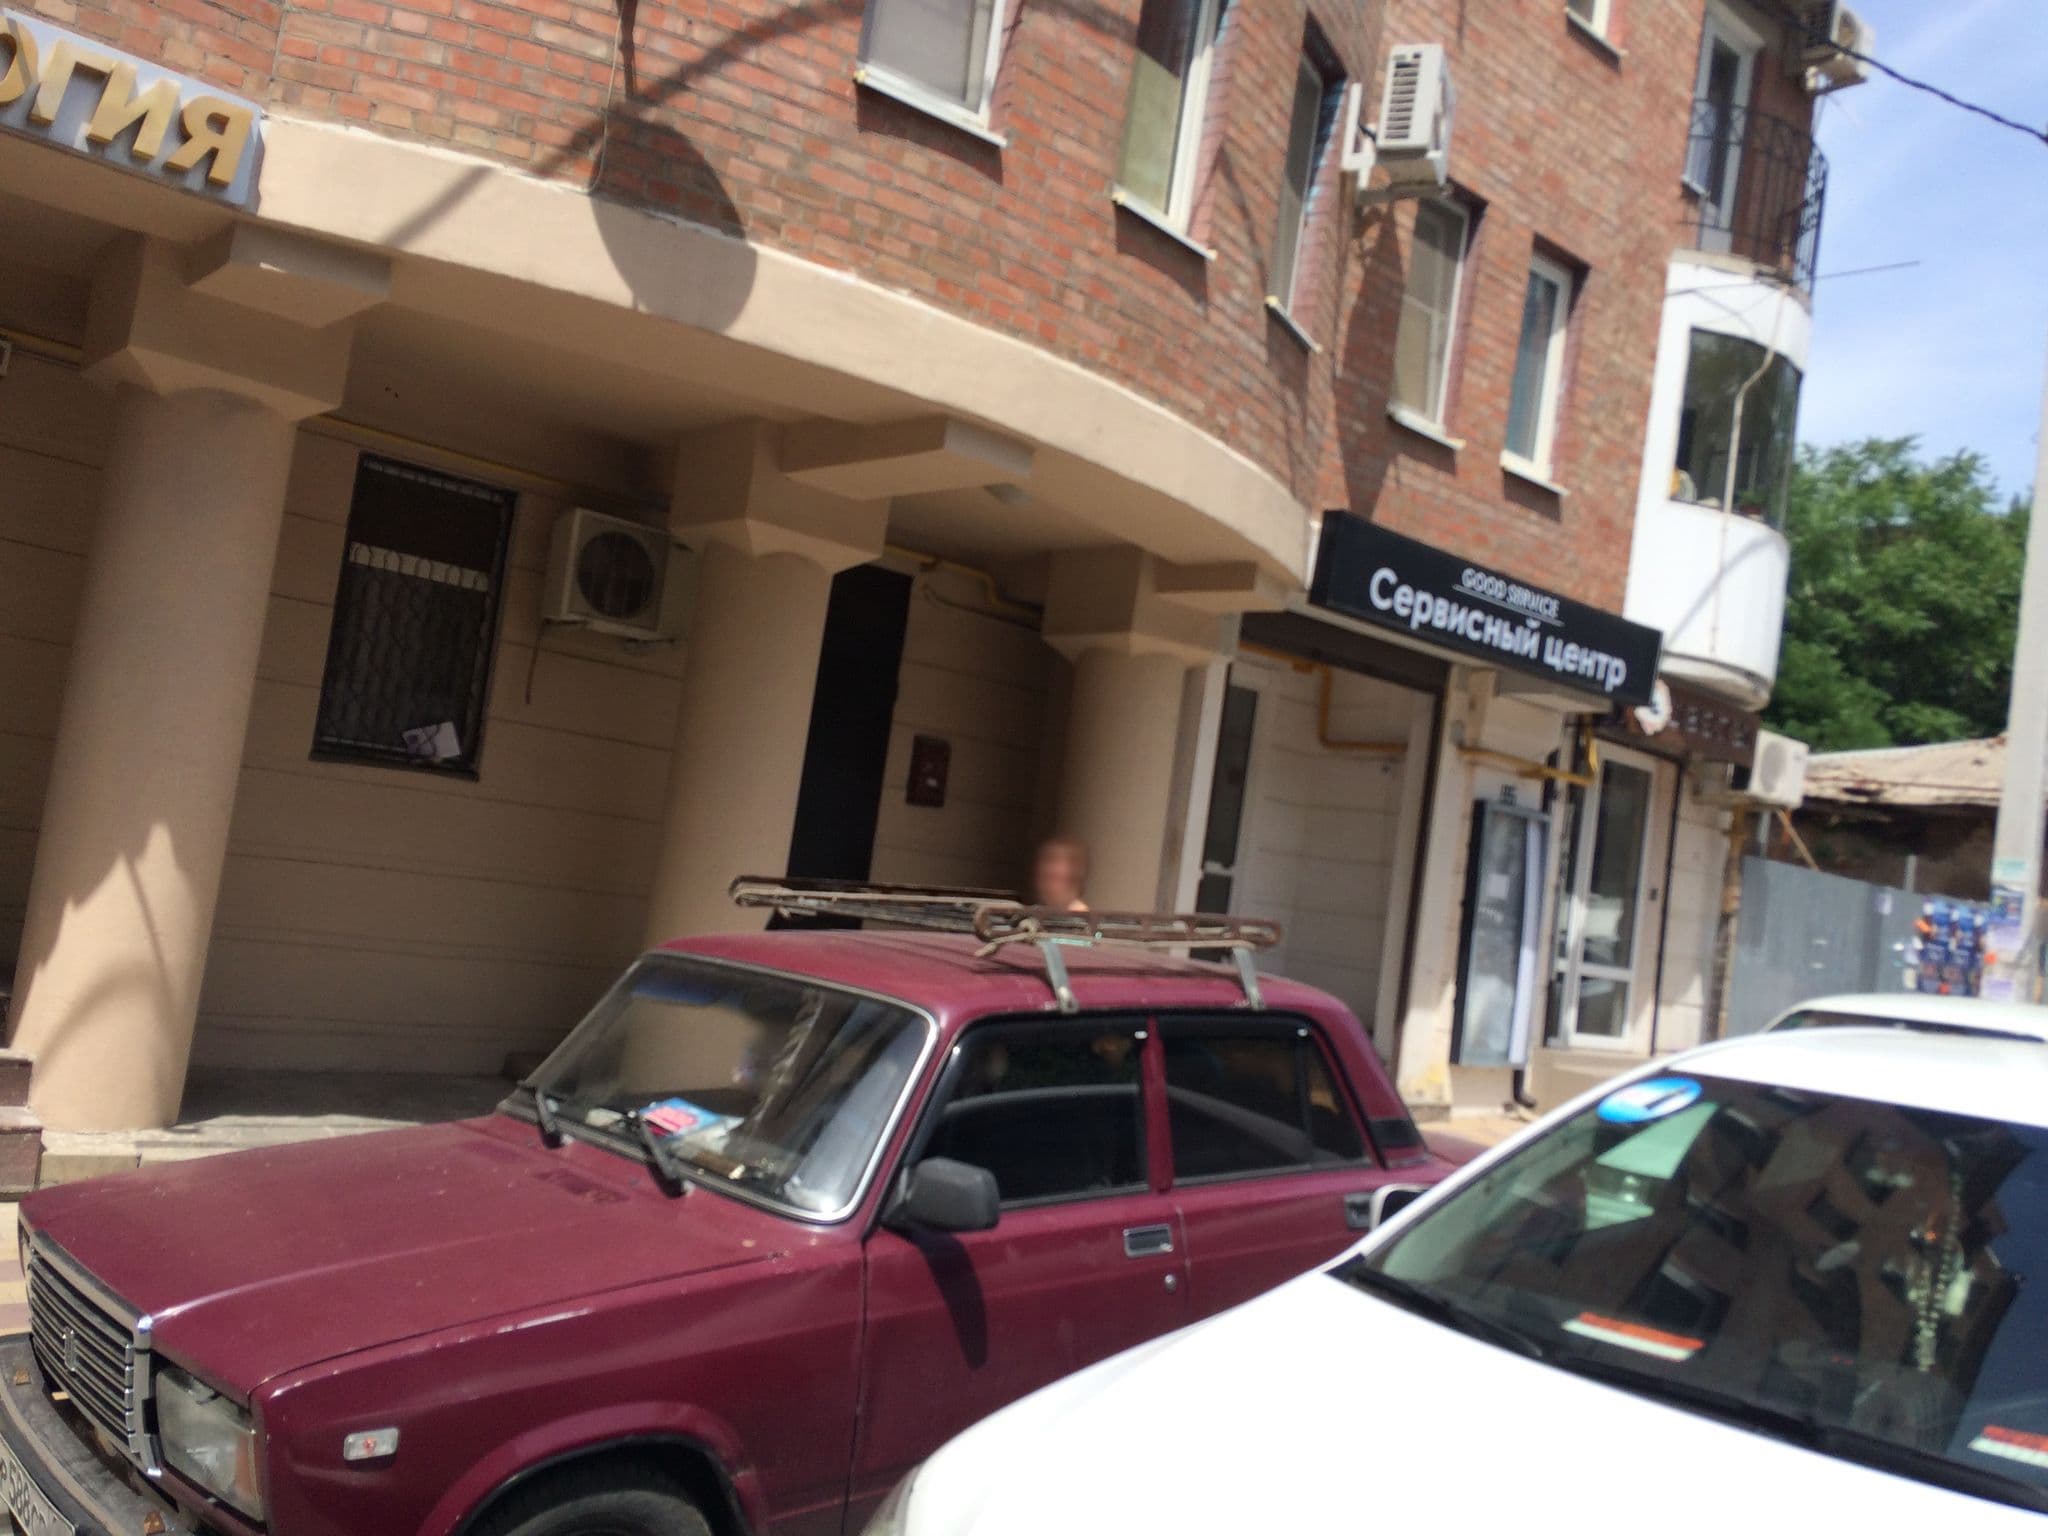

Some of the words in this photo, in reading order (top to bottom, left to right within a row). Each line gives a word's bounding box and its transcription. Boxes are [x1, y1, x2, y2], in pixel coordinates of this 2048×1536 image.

[1369, 567, 1541, 659] Сервисный
[1543, 635, 1627, 692] центр
[1462, 567, 1507, 600] GOOD
[1506, 584, 1560, 618] SERVICE
